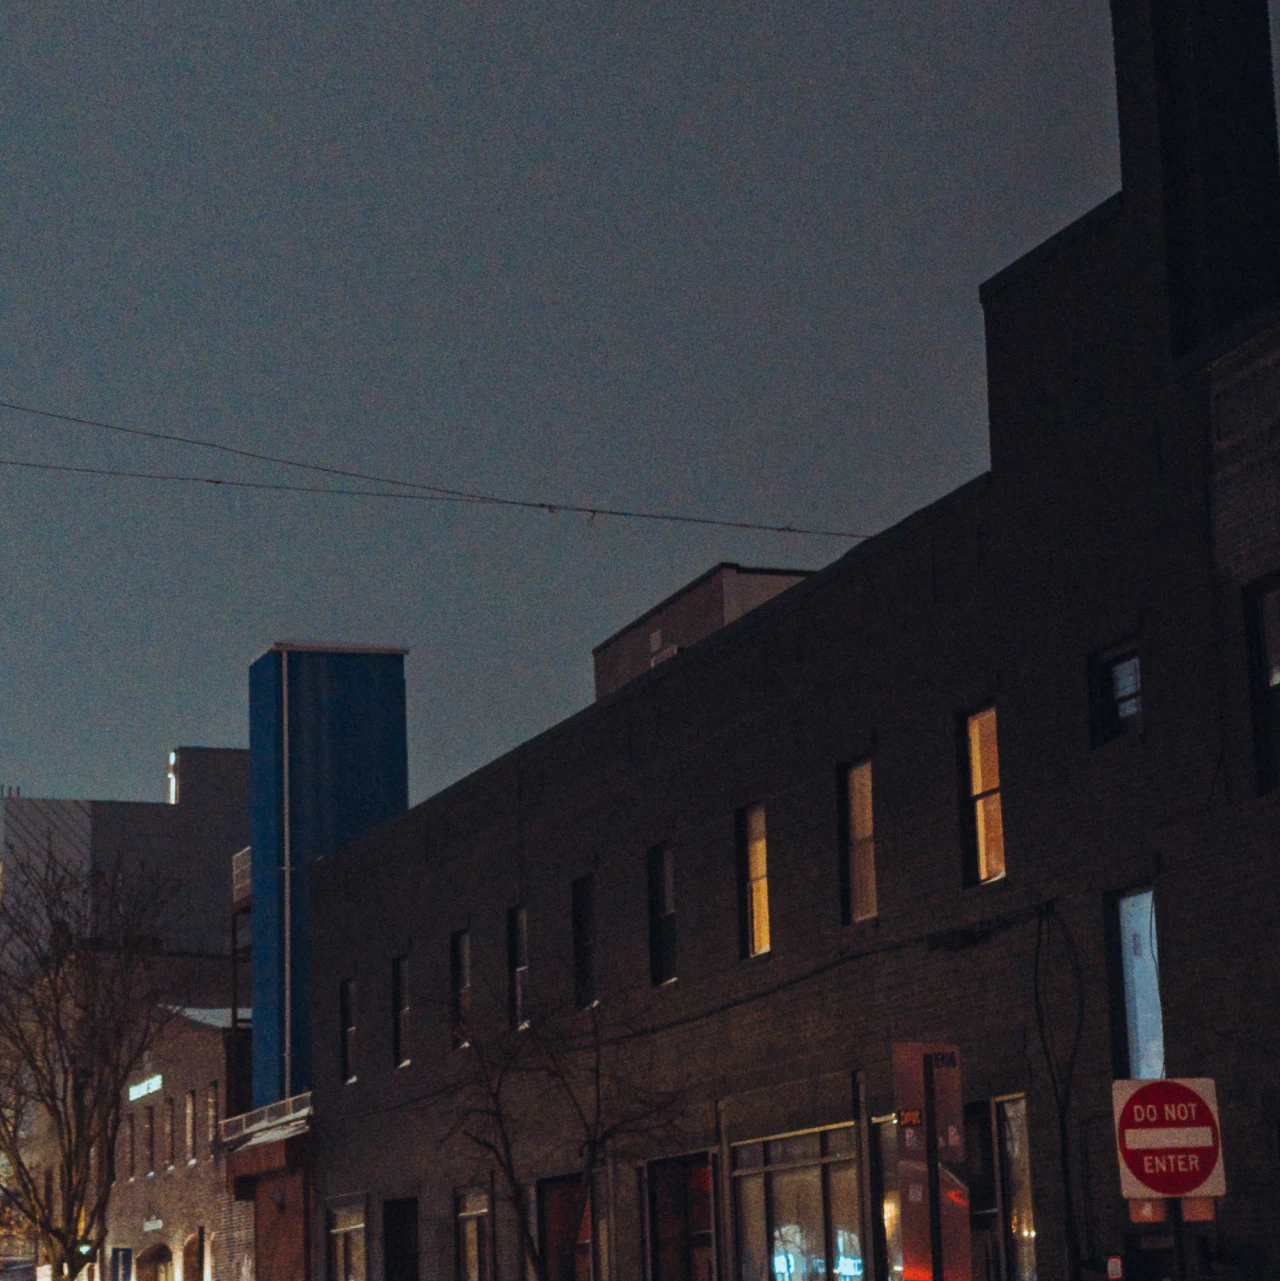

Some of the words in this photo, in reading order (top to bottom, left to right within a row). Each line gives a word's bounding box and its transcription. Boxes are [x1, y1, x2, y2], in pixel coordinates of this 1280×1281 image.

[1133, 1104, 1158, 1122] DO
[1163, 1103, 1197, 1121] NOT
[1143, 1154, 1200, 1174] ENTER
